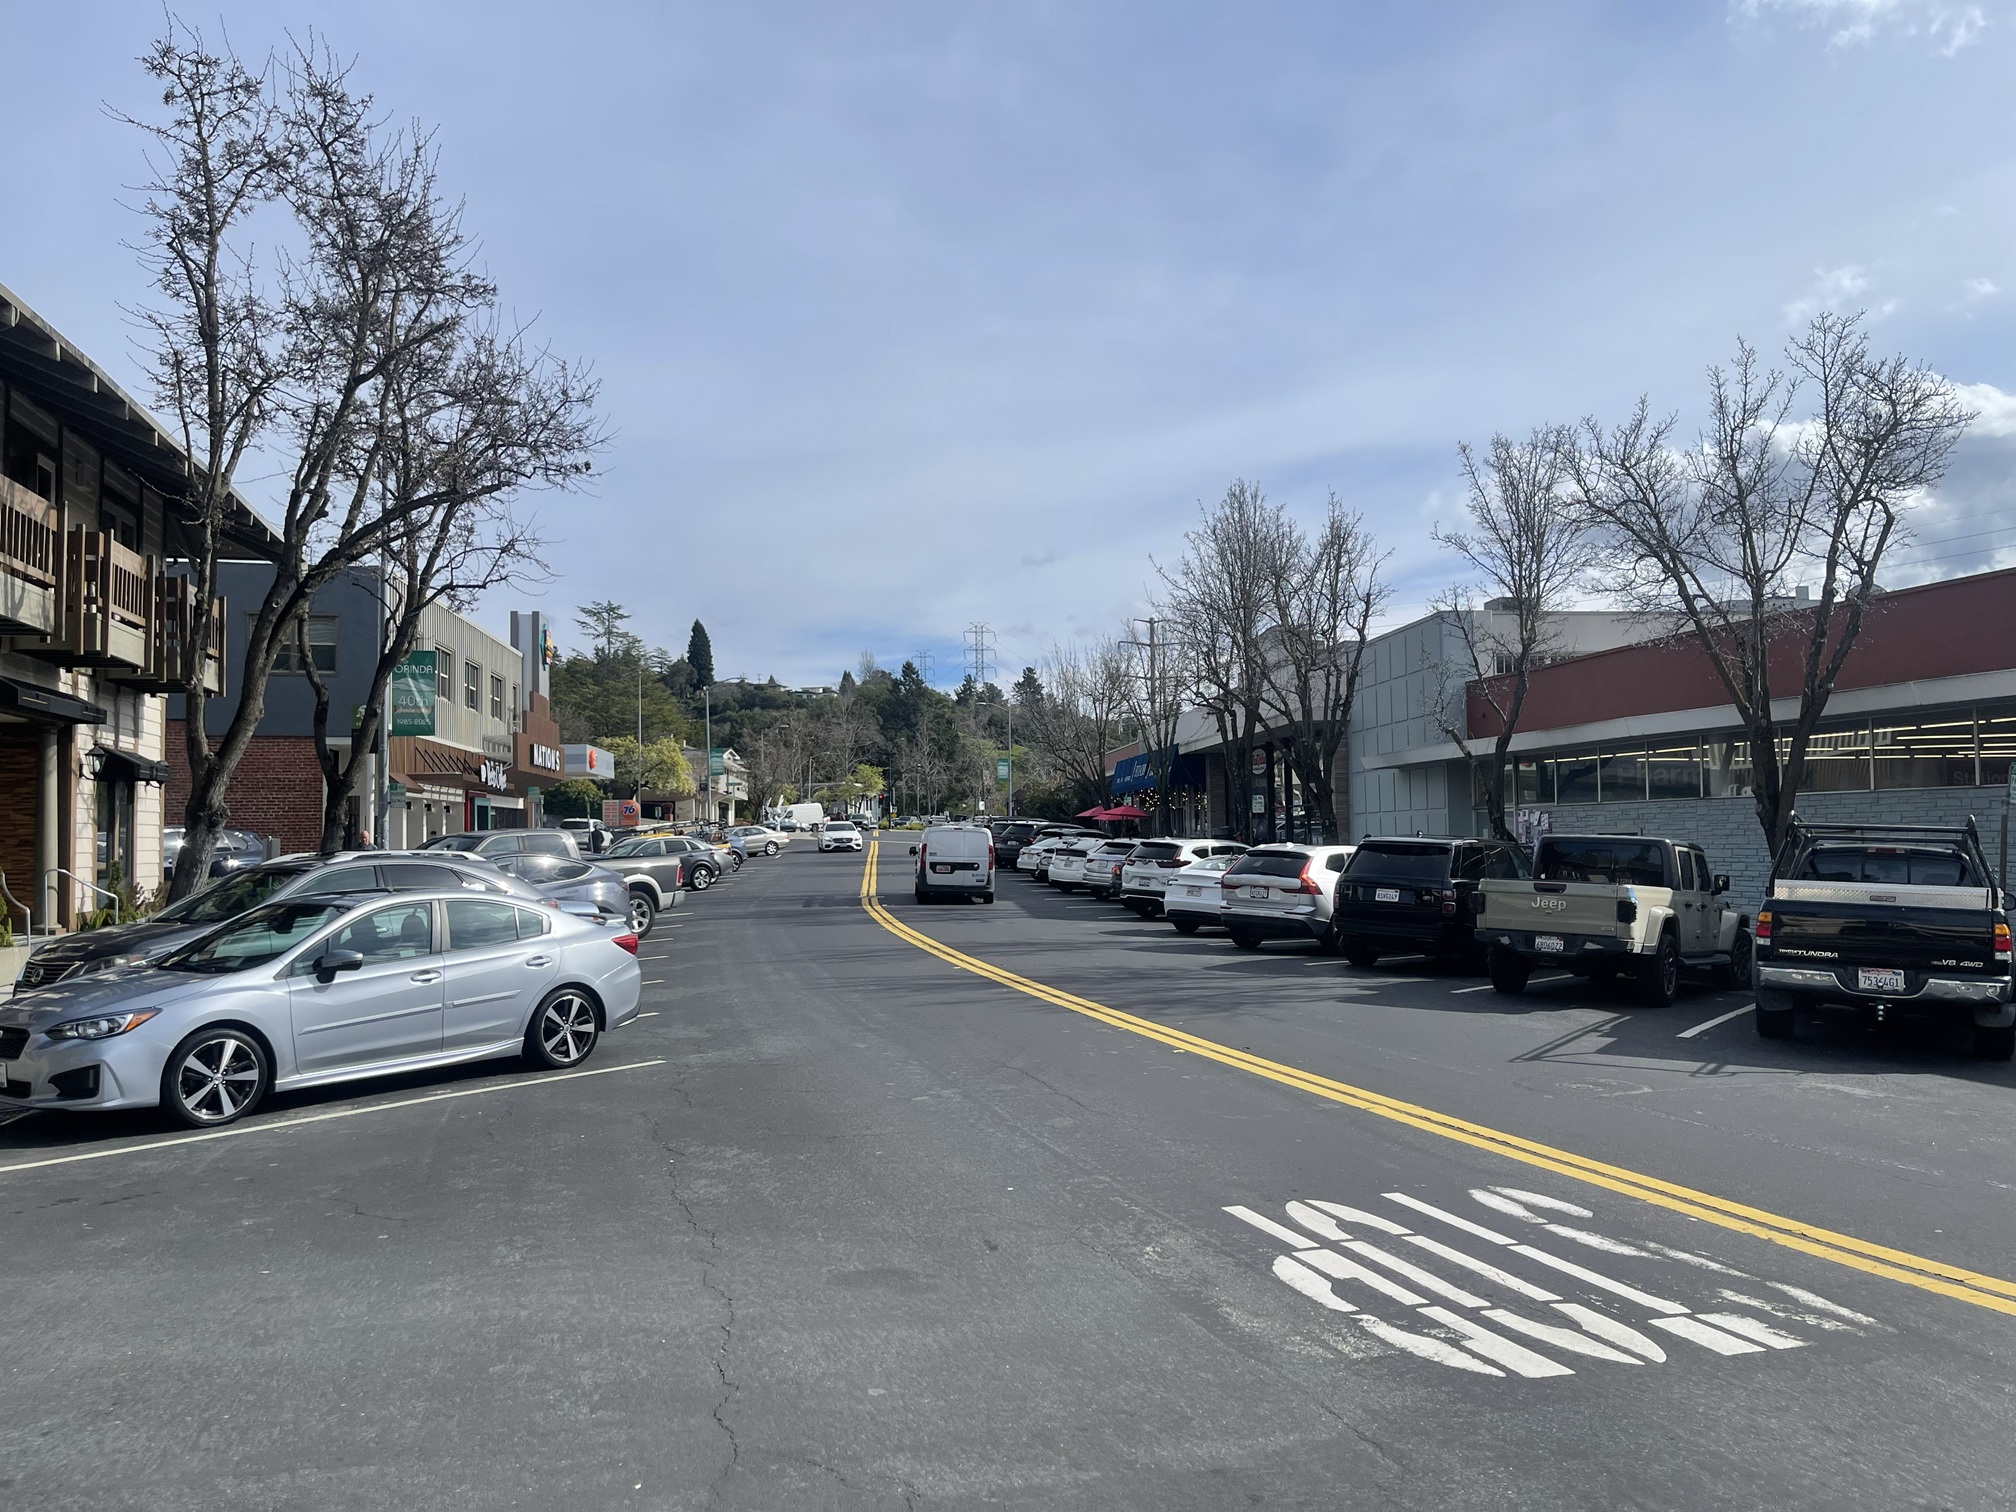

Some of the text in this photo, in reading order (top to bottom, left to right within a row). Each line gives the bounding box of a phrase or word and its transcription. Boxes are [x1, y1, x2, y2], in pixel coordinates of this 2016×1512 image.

[394, 664, 433, 674] ORINDA
[398, 695, 429, 707] 40th
[396, 718, 431, 726] 1985-2025
[623, 805, 635, 815] 76
[1531, 896, 1567, 912] Jeep
[1797, 950, 1839, 958] TUNDRA
[1221, 1185, 1878, 1378] STOP
